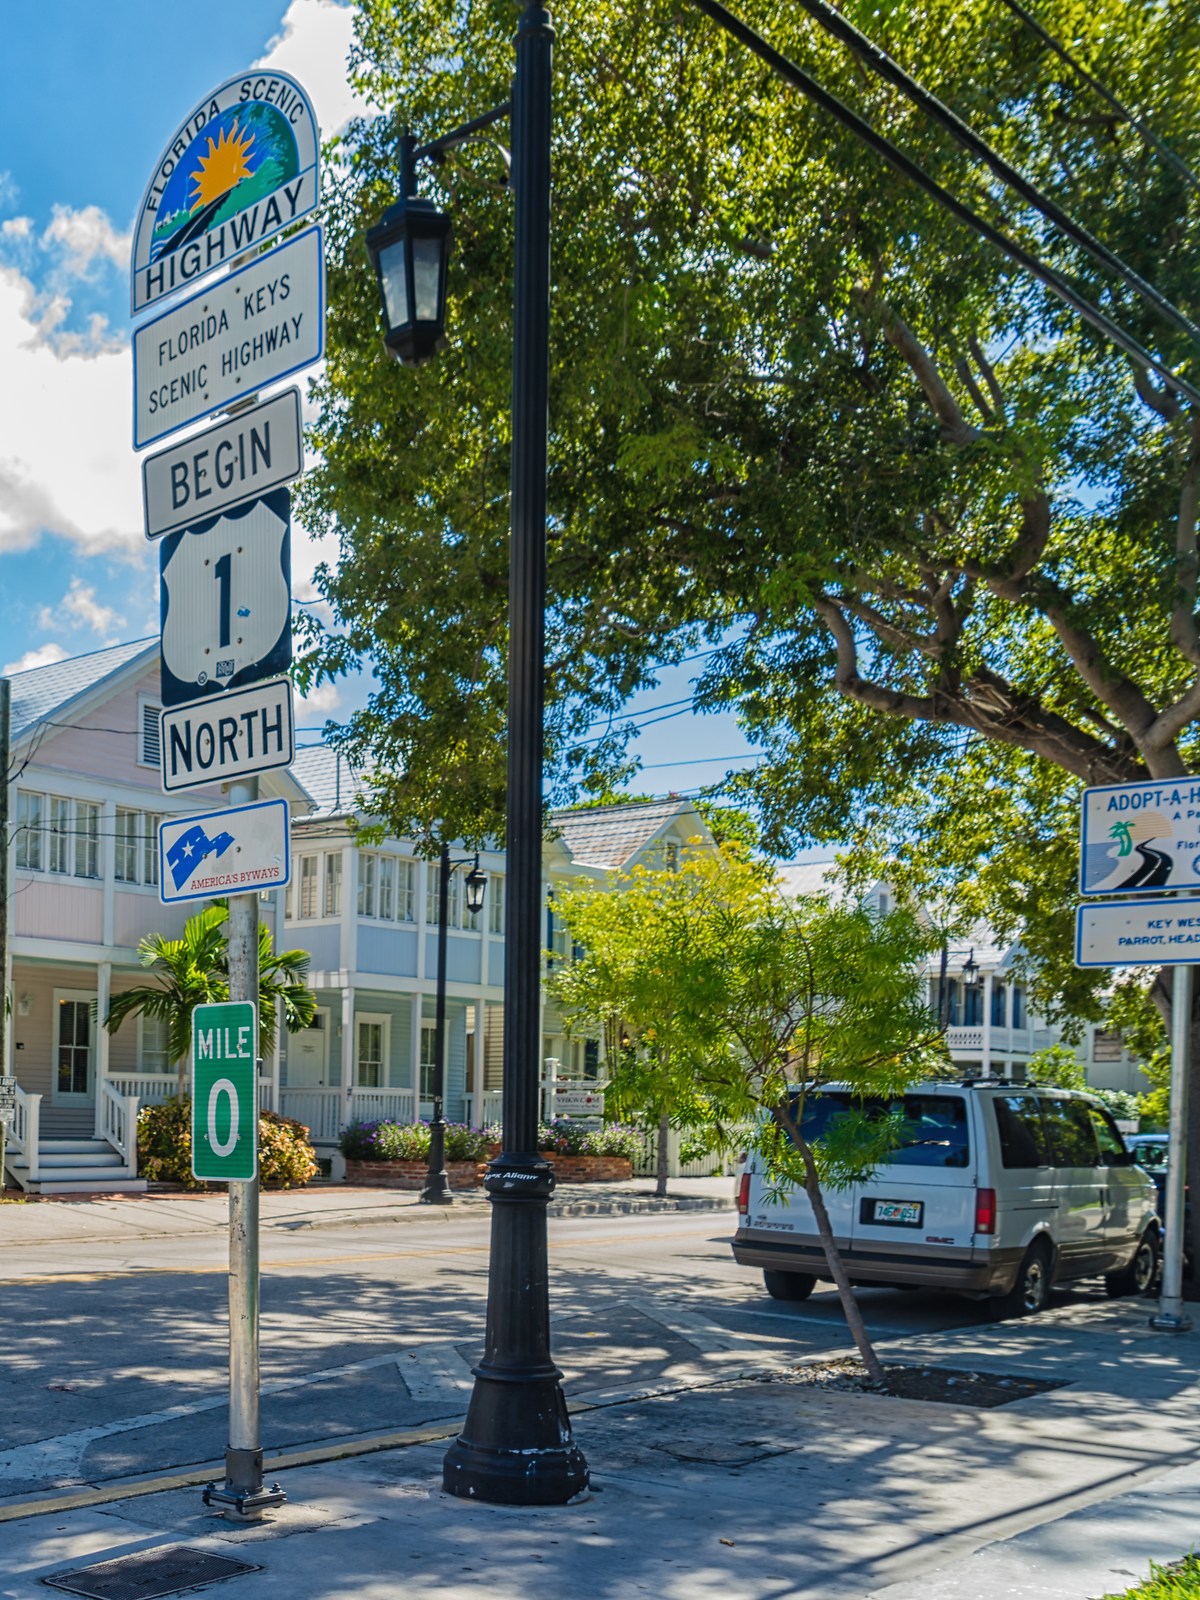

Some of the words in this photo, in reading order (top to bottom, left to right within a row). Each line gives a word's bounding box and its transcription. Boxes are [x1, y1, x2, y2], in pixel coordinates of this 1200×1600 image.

[147, 99, 220, 213] FLORIDA
[239, 78, 304, 125] SCENIC
[145, 178, 304, 300] HIGHWAY
[158, 313, 229, 366] FLORIDA
[244, 274, 291, 321] KEYS
[149, 365, 208, 414] SCENIC
[222, 313, 304, 377] HIGHWAY
[170, 421, 272, 510] BEGIN
[214, 553, 231, 648] 1
[170, 703, 283, 776] NORTH
[1173, 811, 1182, 820] A
[191, 873, 238, 890] AMERICA'S
[240, 867, 280, 882] BYWAYS
[1148, 919, 1173, 929] KEY
[199, 1026, 251, 1059] MILE
[207, 1078, 240, 1158] 0
